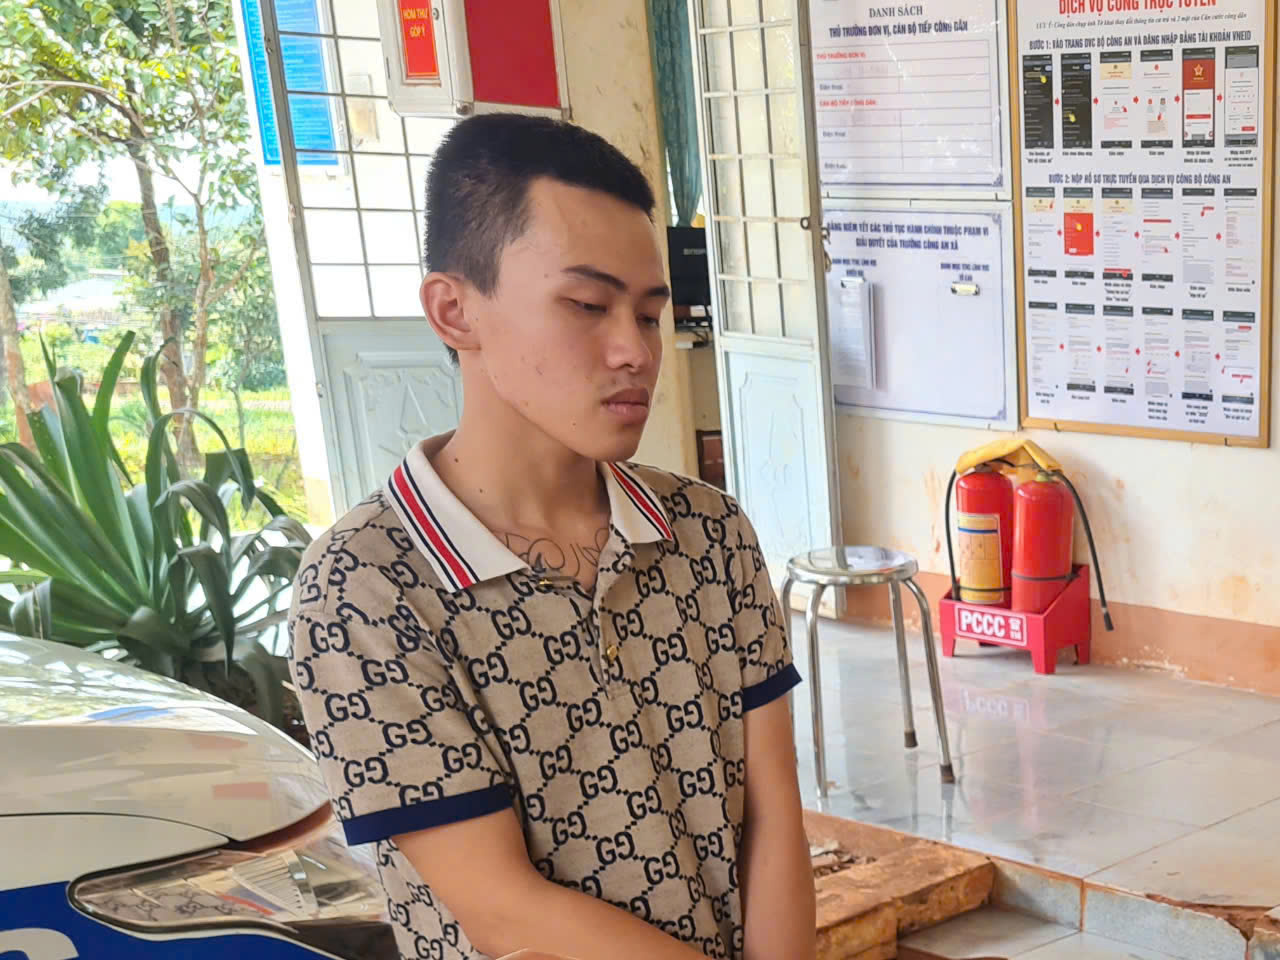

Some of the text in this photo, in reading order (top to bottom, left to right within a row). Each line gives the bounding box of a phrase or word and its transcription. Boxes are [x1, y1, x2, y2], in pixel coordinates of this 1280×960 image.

[869, 4, 923, 18] DANH SÁCH
[960, 610, 1006, 638] PCCC
